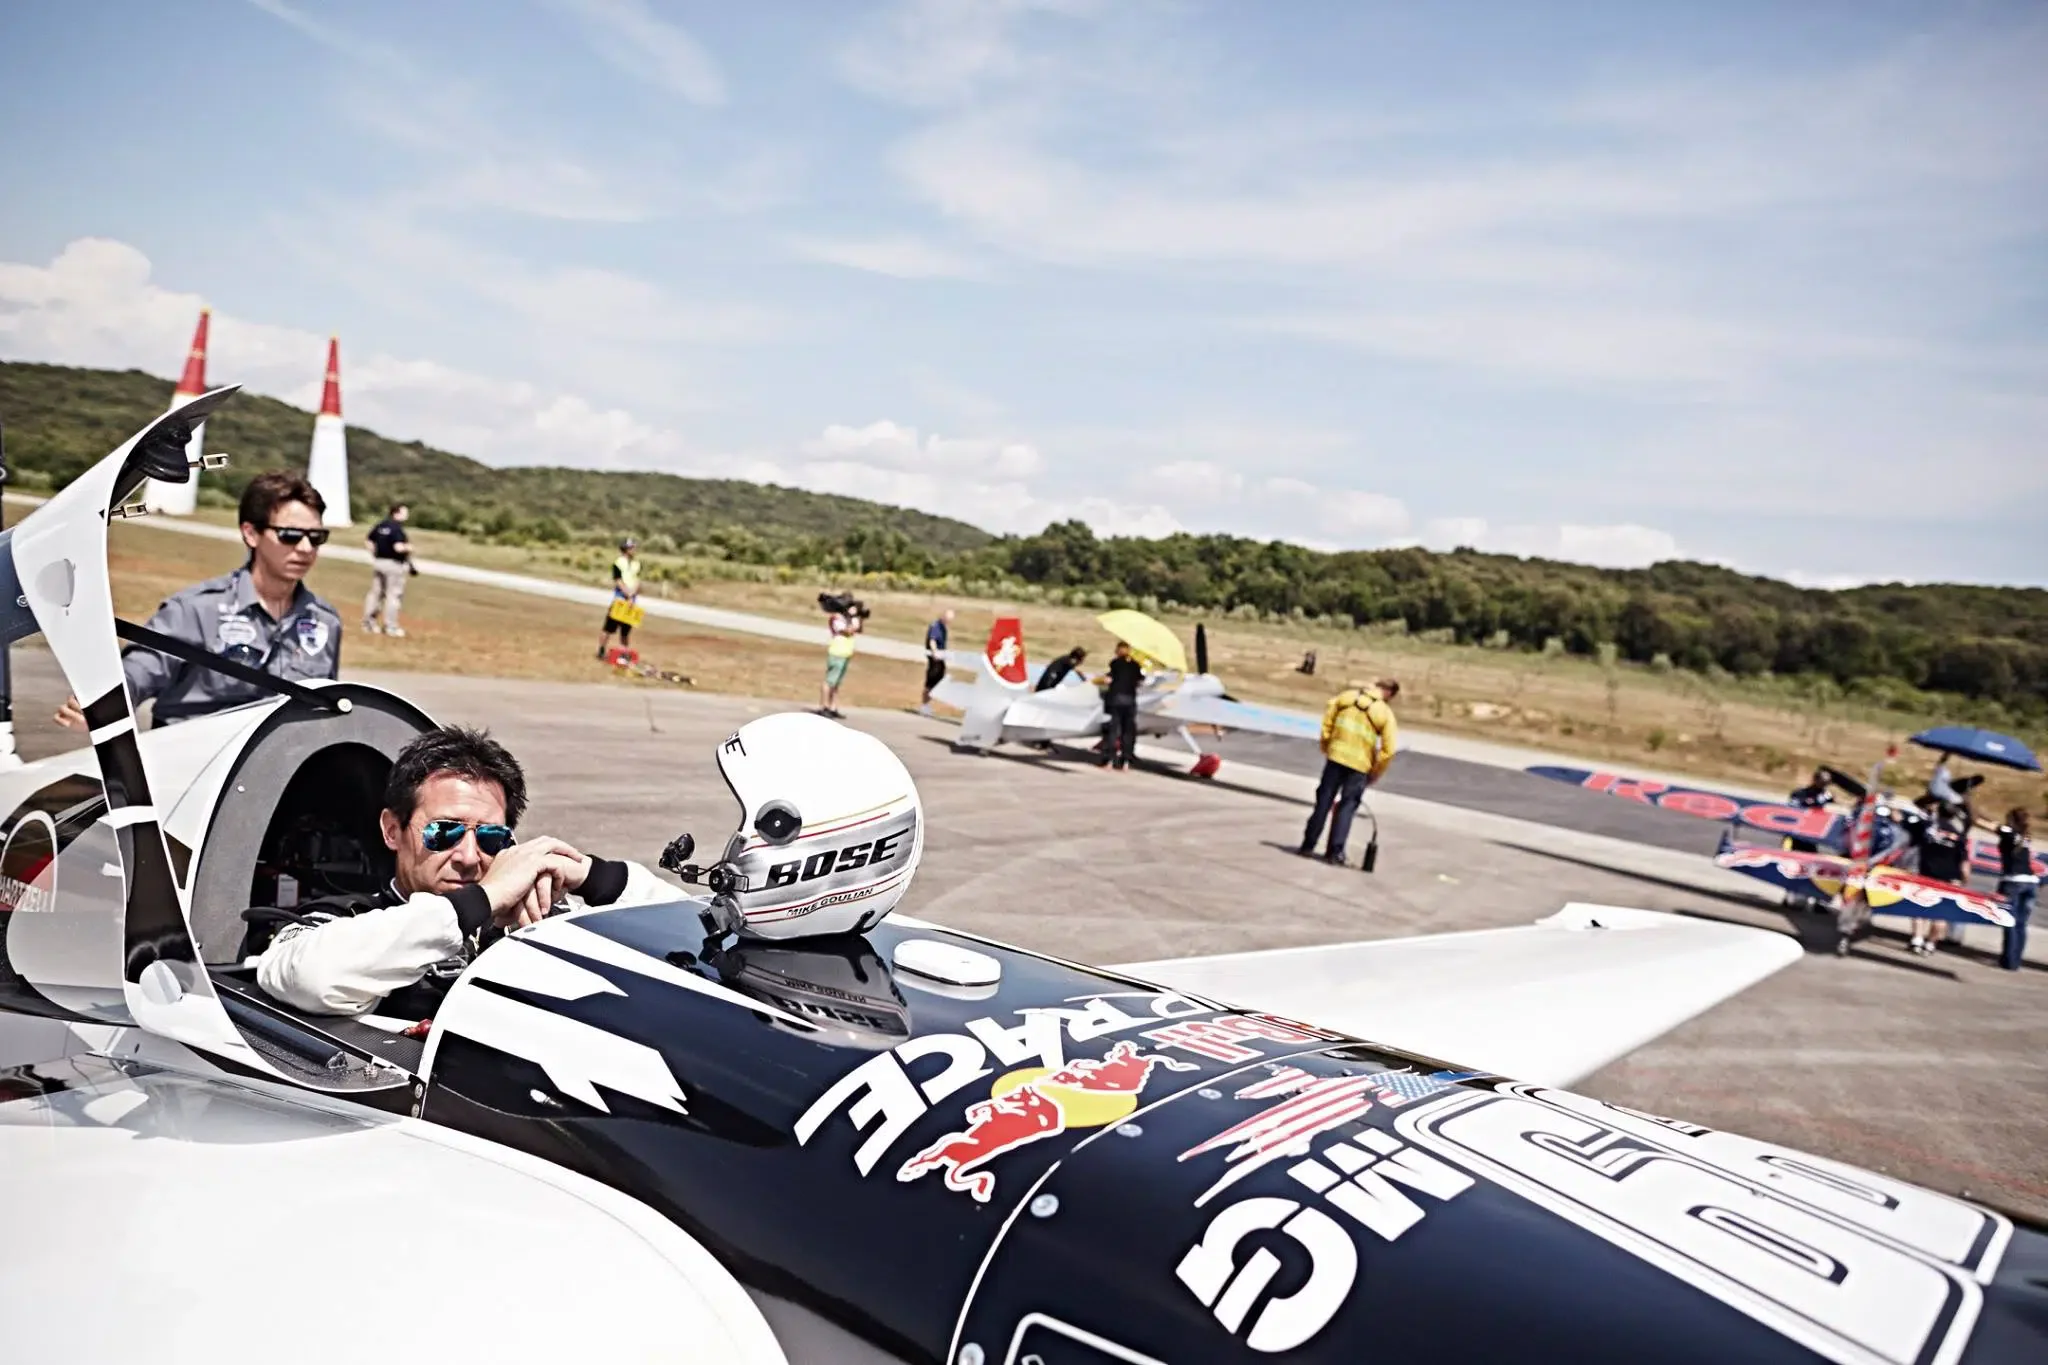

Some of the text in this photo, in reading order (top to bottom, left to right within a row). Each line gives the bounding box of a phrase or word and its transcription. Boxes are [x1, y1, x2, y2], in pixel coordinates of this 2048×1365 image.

[1582, 770, 1839, 838] Red
[748, 828, 909, 893] BOSE
[786, 887, 874, 917] MIKE GOULIAN
[793, 997, 1165, 1177] RACE
